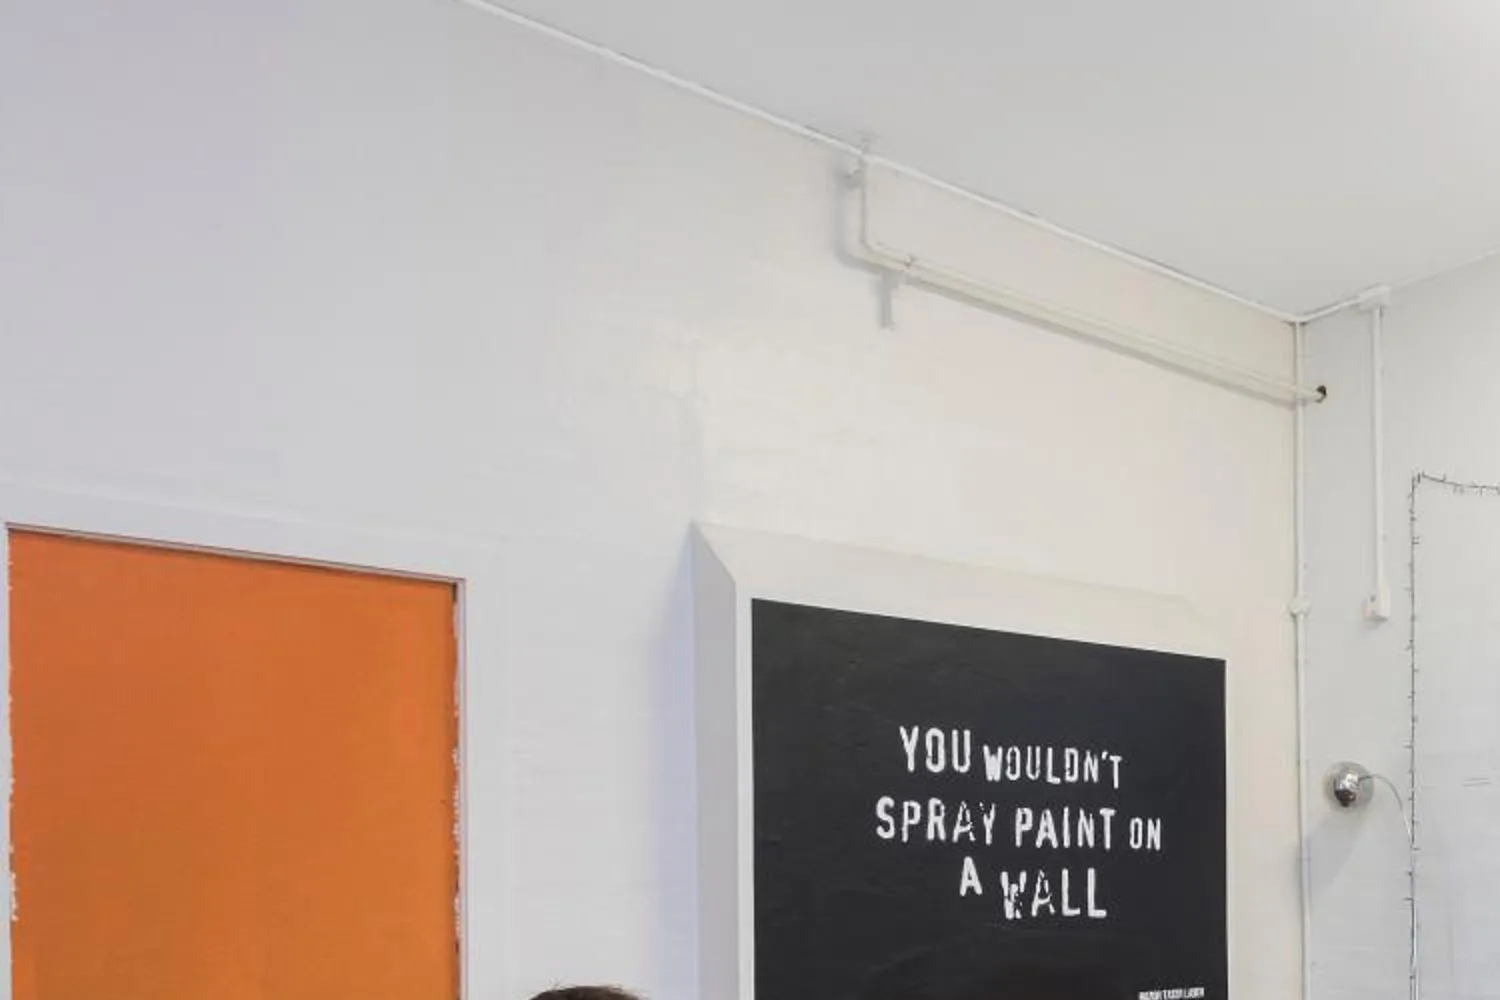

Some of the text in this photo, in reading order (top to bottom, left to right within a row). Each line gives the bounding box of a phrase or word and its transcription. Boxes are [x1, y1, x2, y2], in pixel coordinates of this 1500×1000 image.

[899, 725, 1123, 790] YOU WOULDN'T
[875, 795, 1161, 851] SPRAY PAINT ON
[959, 855, 1108, 921] A WALL
